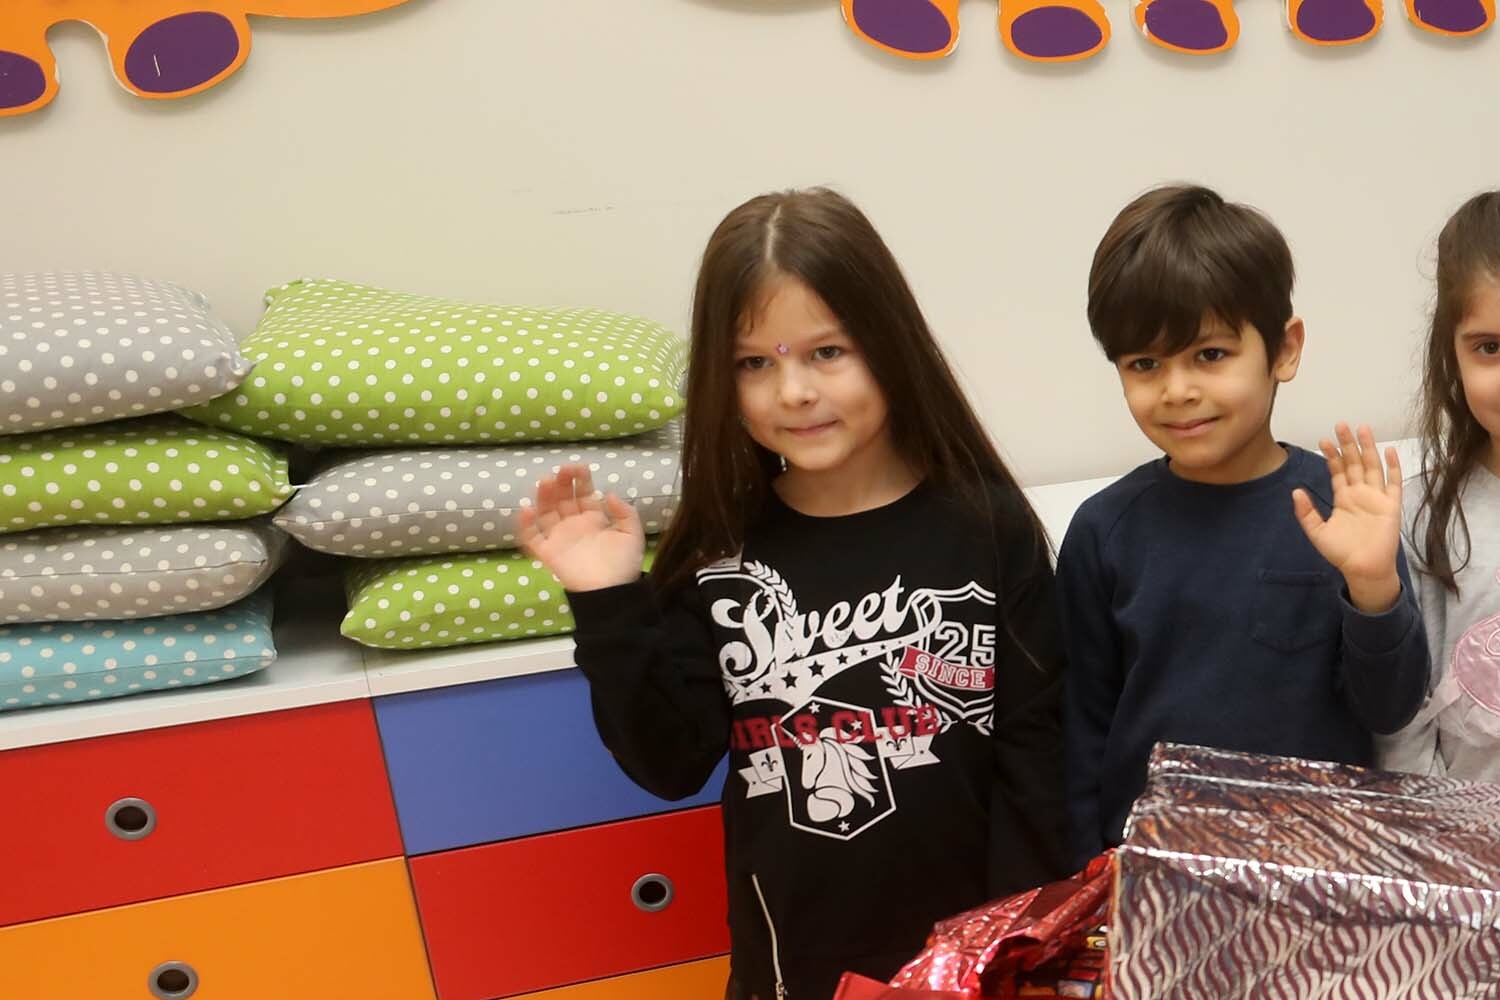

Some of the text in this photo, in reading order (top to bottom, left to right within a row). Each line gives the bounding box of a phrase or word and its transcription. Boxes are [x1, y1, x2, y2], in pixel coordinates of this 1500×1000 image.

[711, 574, 906, 682] Sweet
[935, 621, 996, 667] 25
[915, 653, 986, 688] SINCE
[732, 703, 941, 749] IRLS CLUB
